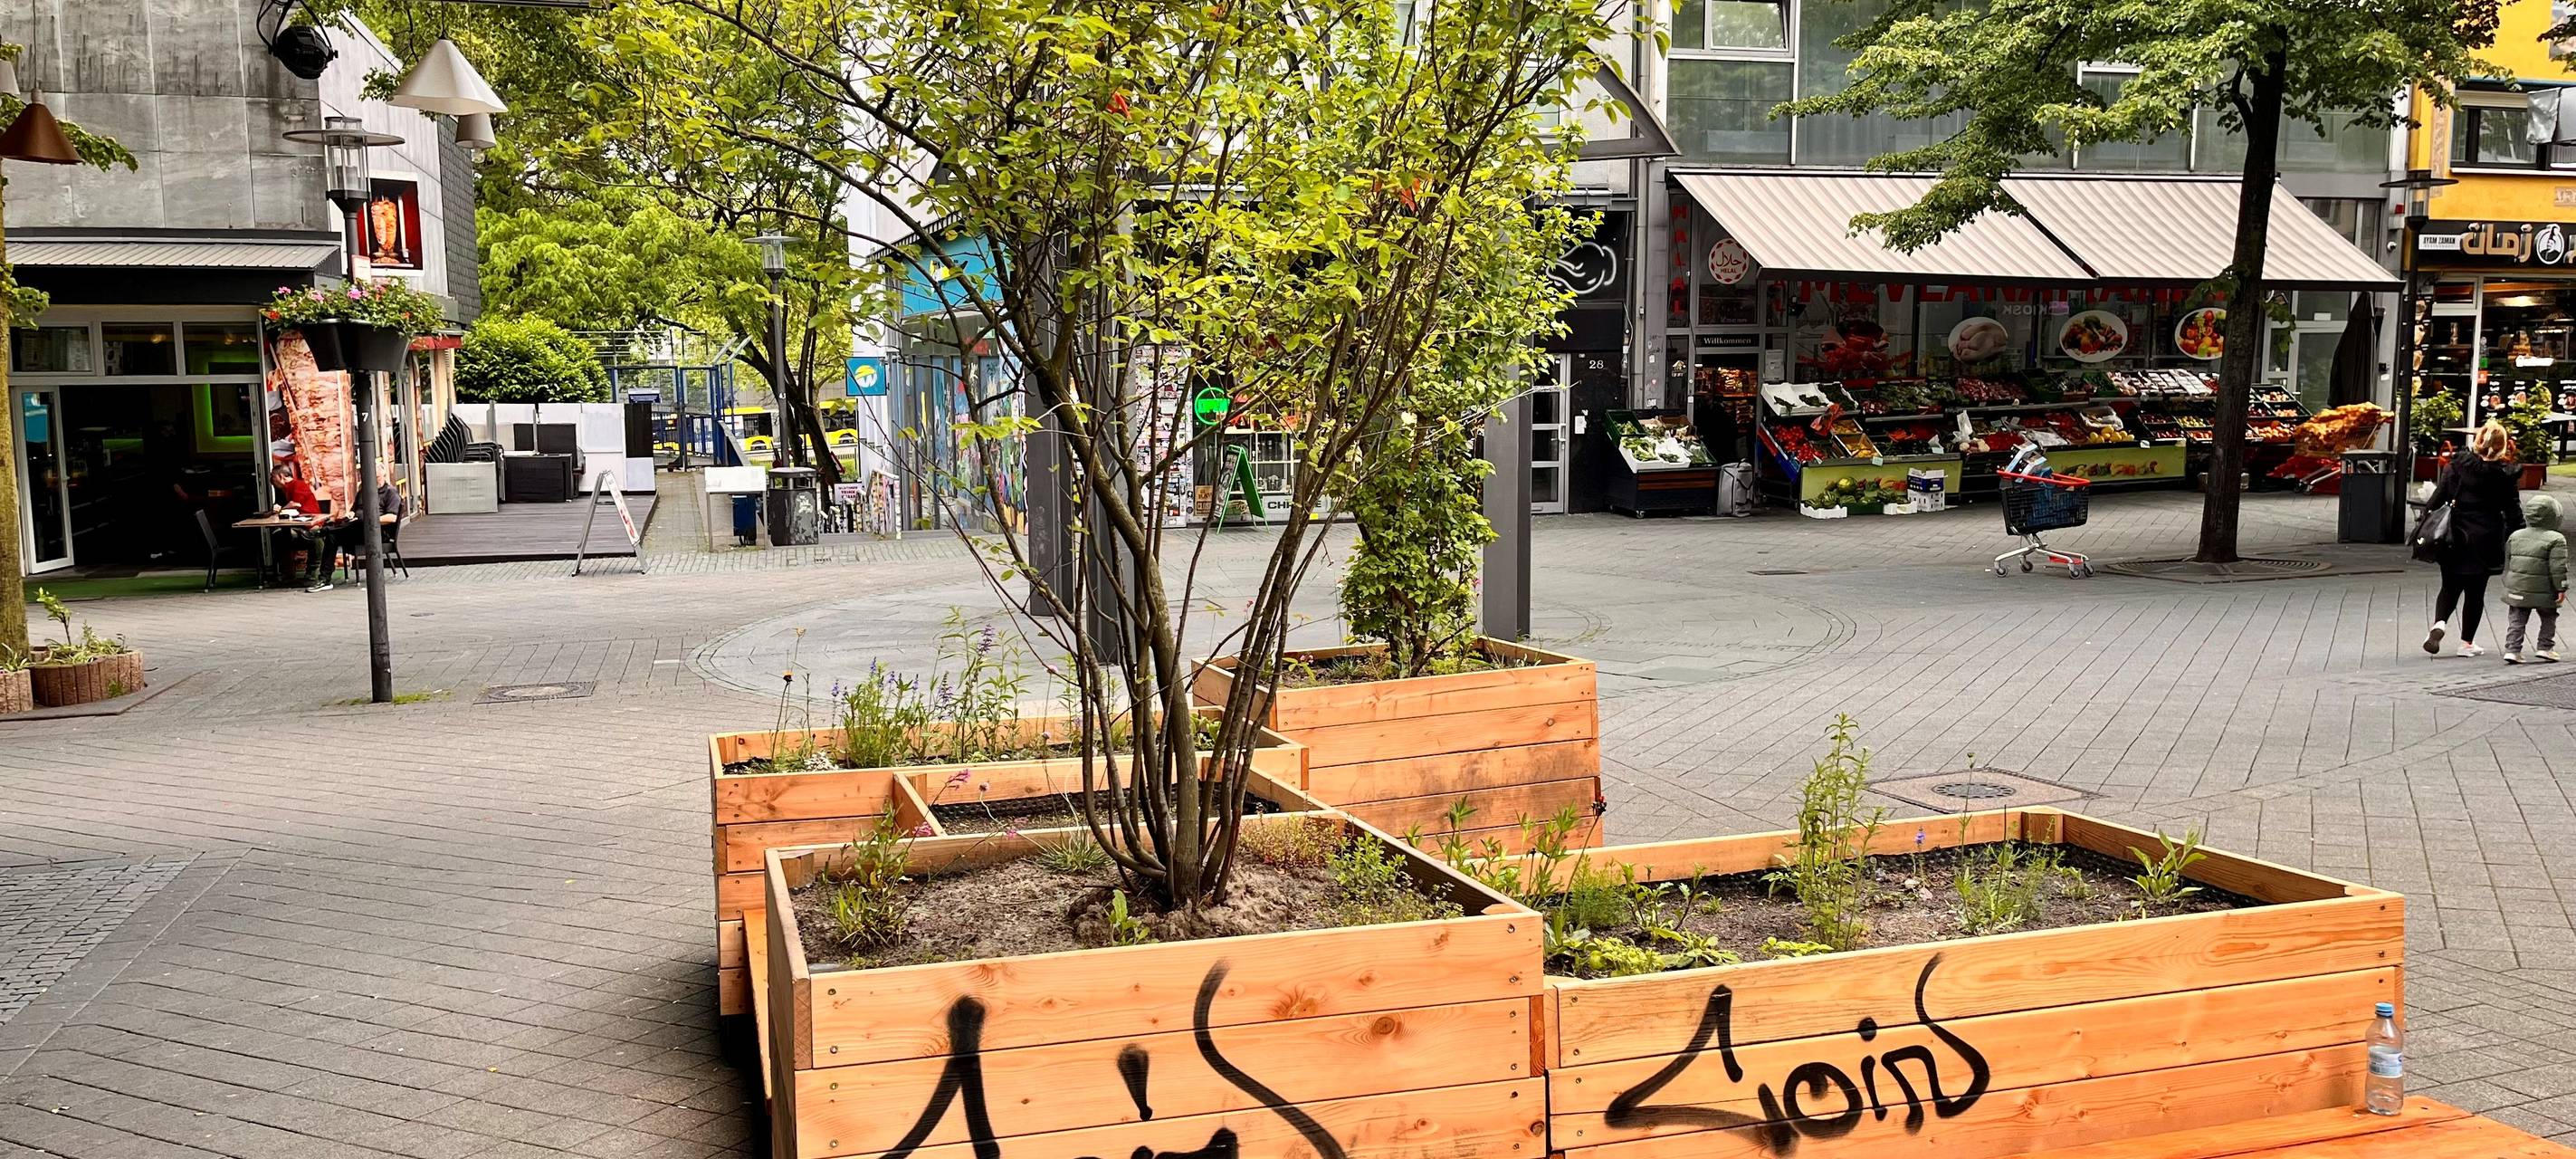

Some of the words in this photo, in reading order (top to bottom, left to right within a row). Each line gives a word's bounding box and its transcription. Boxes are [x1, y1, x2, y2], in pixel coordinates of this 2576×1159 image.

[1672, 203, 1688, 316] HALAL
[1715, 251, 1742, 267] حلال
[1703, 337, 1751, 345] Willkommen
[1589, 359, 1604, 369] 28
[361, 412, 368, 422] 7
